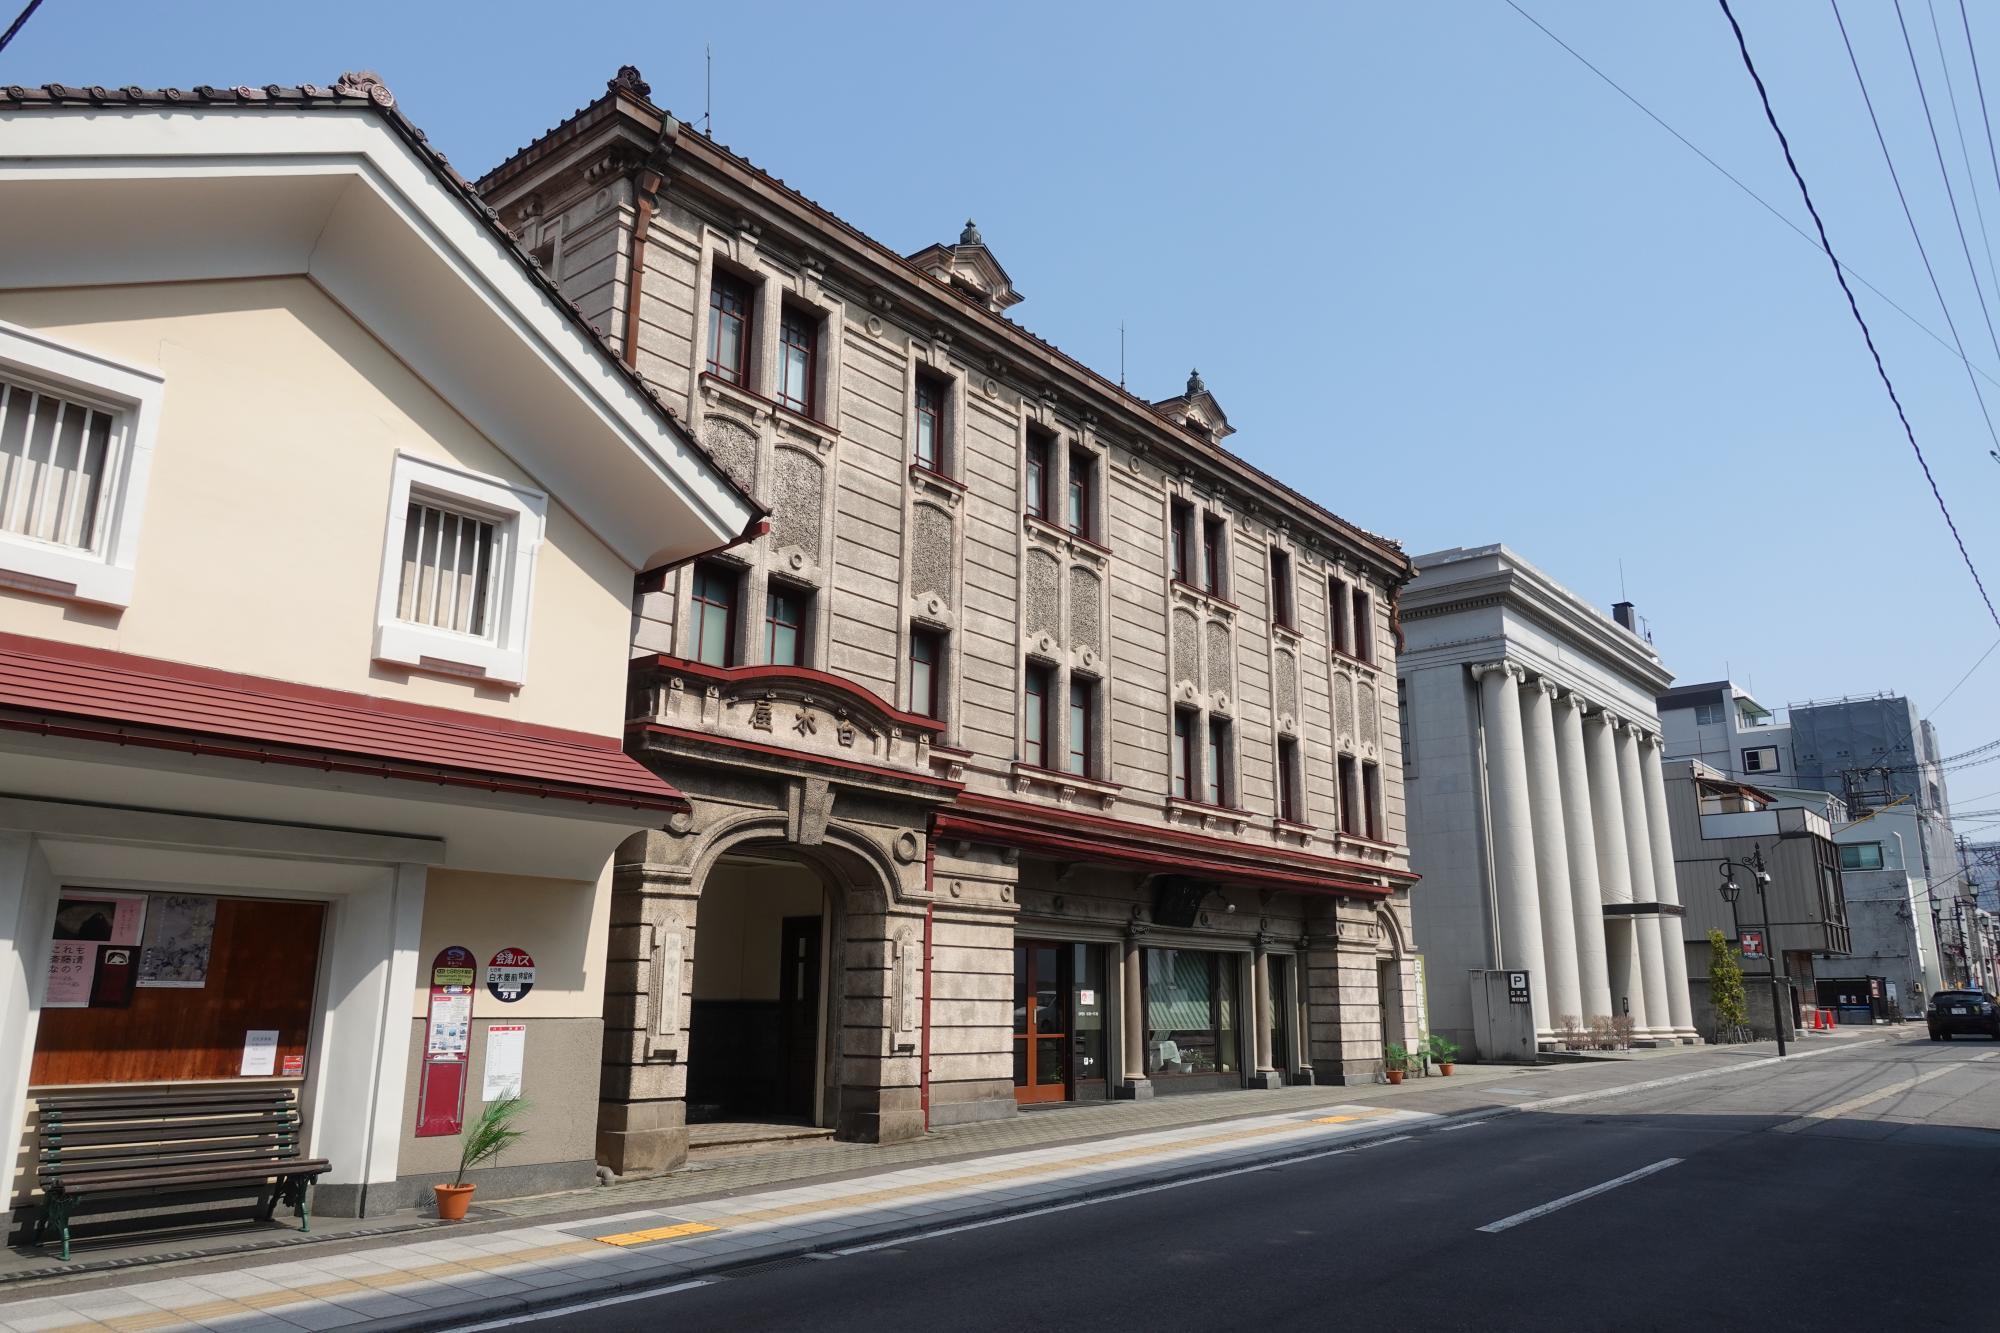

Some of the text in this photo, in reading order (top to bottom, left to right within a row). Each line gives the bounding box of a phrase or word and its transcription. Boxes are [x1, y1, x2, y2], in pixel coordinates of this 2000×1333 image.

[52, 945, 85, 954] これも
[496, 952, 530, 966] 会津バス
[1514, 976, 1521, 986] P
